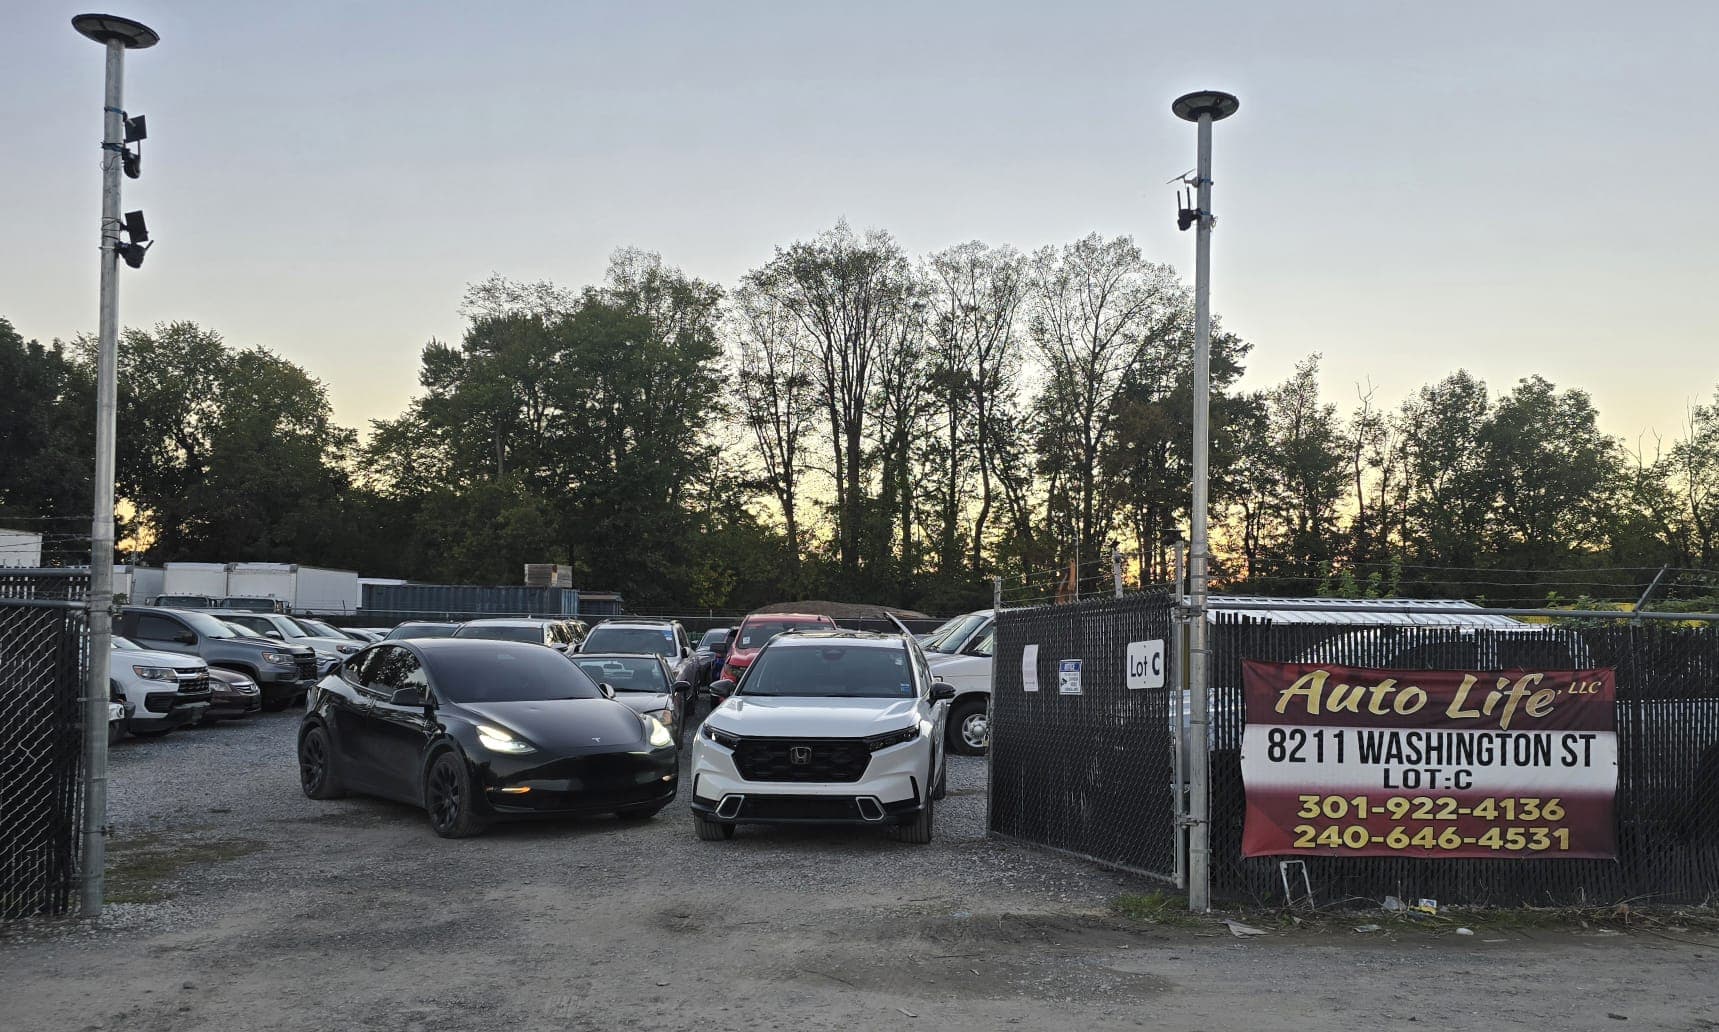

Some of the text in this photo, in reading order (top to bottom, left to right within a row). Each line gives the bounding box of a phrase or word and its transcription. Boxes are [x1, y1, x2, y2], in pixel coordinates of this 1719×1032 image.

[1130, 652, 1160, 677] Lot C
[1274, 669, 1428, 715] Auto
[1568, 681, 1602, 694] LLC
[1267, 728, 1596, 767] 8211 WASHINGTON ST
[1383, 768, 1473, 790] LOT:C
[1297, 795, 1566, 820] 301-922-4136
[1293, 825, 1570, 850] 240-646-4531
